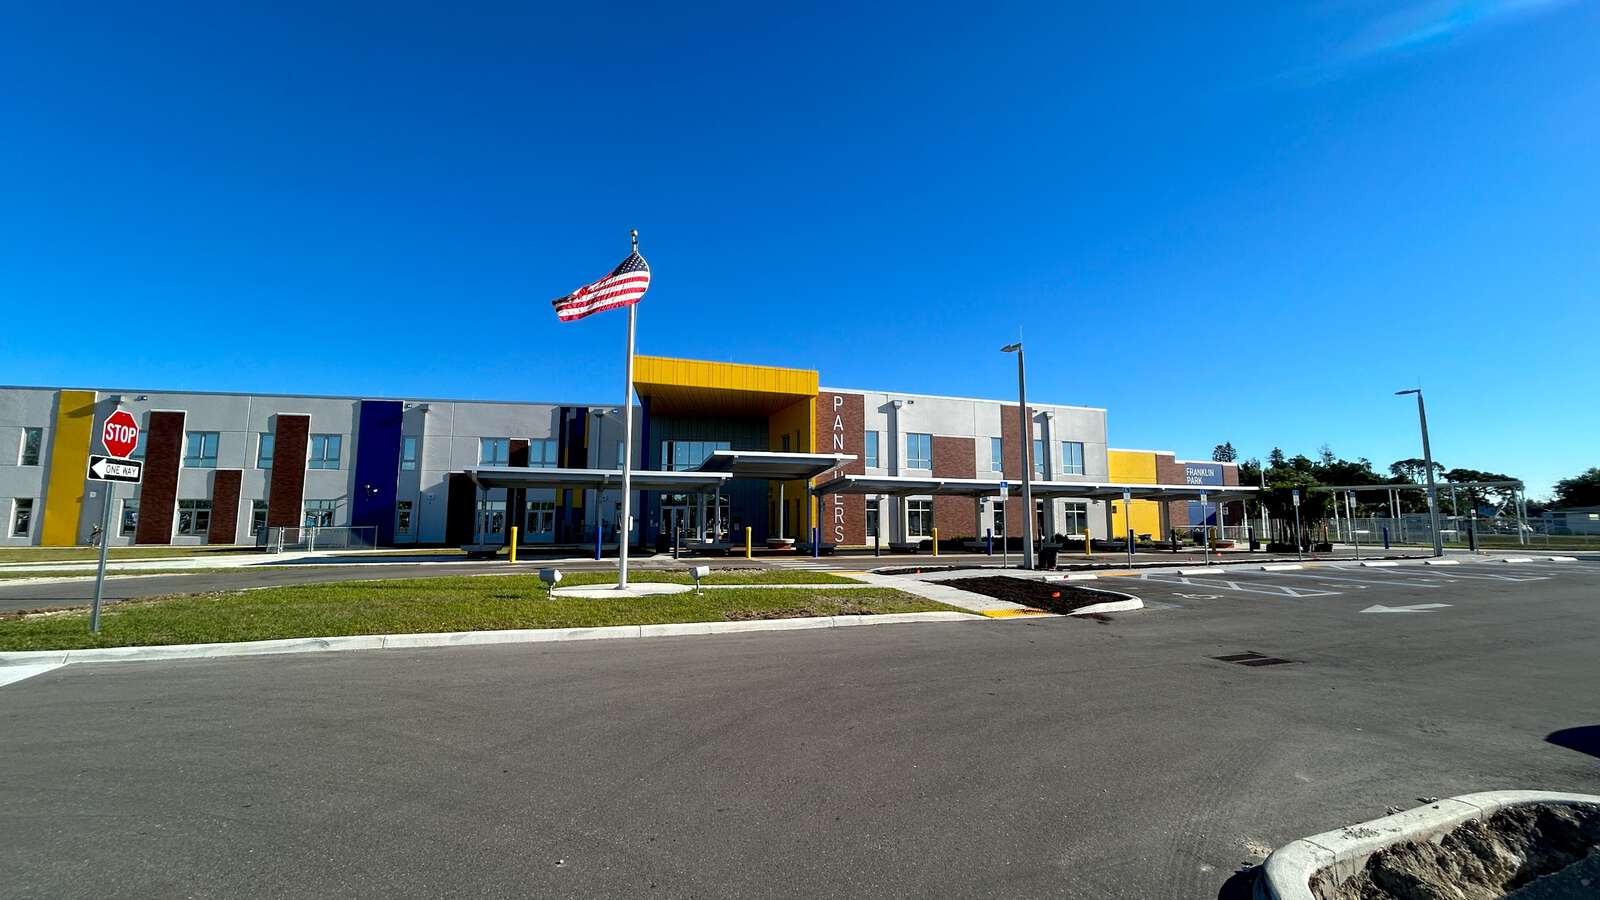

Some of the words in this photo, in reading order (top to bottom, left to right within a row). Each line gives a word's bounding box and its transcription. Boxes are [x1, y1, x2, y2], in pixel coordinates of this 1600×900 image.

[106, 423, 136, 443] STOP
[106, 465, 120, 475] ONE
[122, 467, 136, 476] WAY
[833, 396, 844, 543] PANERS
[1186, 467, 1215, 476] FRANKLIN
[1186, 476, 1203, 484] PARK
